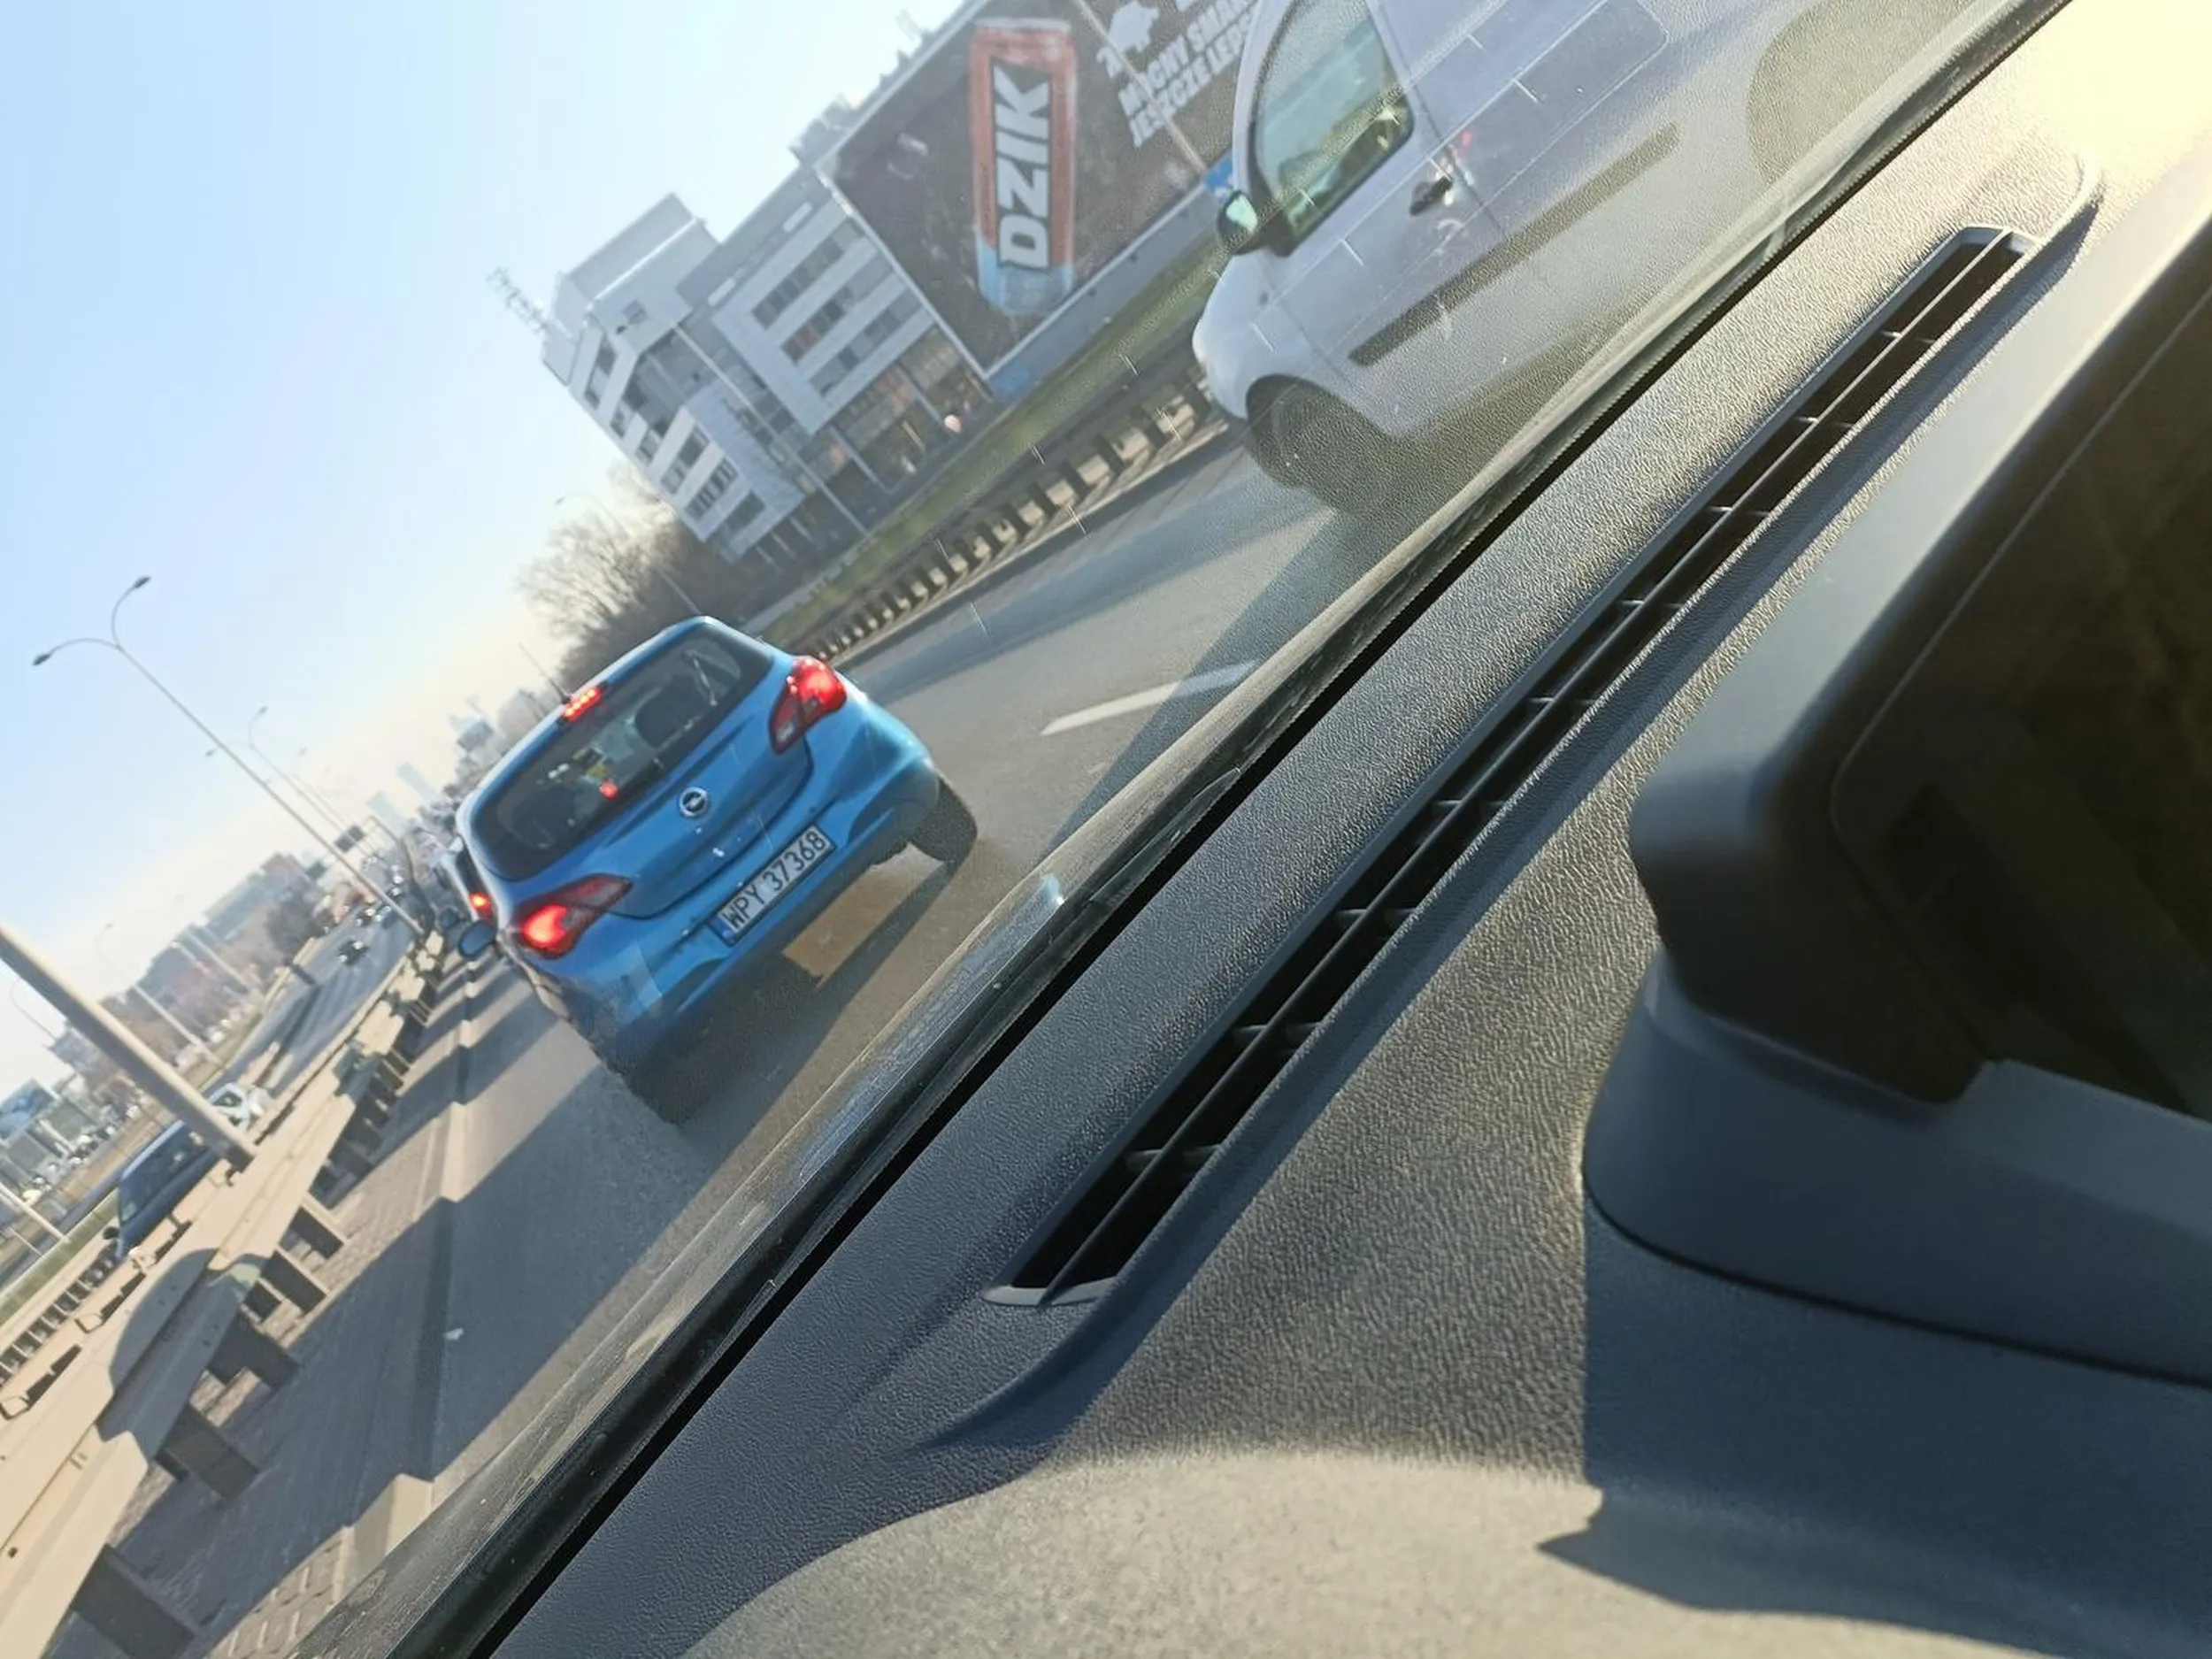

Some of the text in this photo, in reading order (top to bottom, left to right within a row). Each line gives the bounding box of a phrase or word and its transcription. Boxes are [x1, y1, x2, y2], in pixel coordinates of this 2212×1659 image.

[993, 65, 1050, 268] DZIK
[720, 830, 826, 929] WPY 37368
